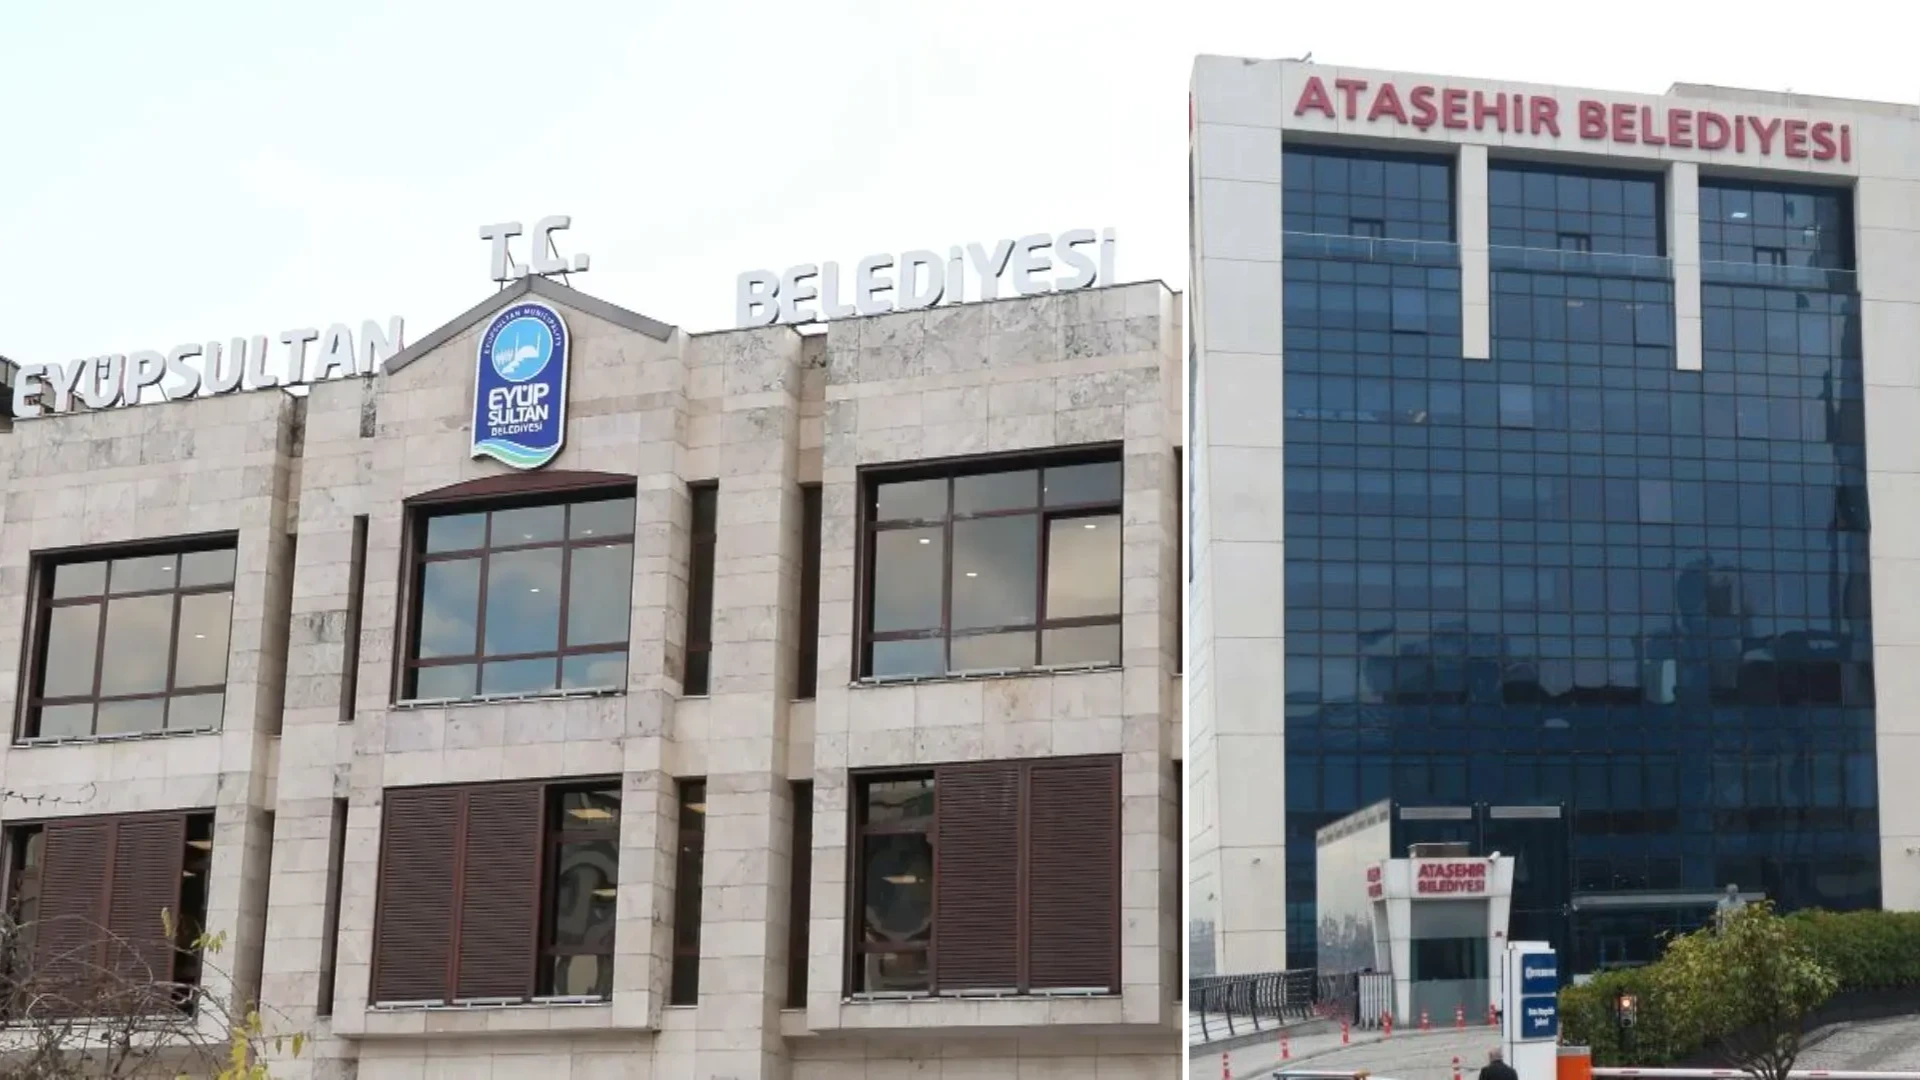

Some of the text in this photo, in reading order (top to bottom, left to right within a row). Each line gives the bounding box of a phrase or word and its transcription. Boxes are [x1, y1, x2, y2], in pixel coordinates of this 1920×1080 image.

[1294, 76, 1852, 163] ATAŞEHİR BELEDİYESİ
[479, 214, 591, 281] T.C.
[736, 226, 1117, 329] BELEDİYESİ
[12, 315, 404, 418] EYÜPSULTAN
[489, 382, 549, 410] EYÜP
[488, 404, 548, 426] SULTAN
